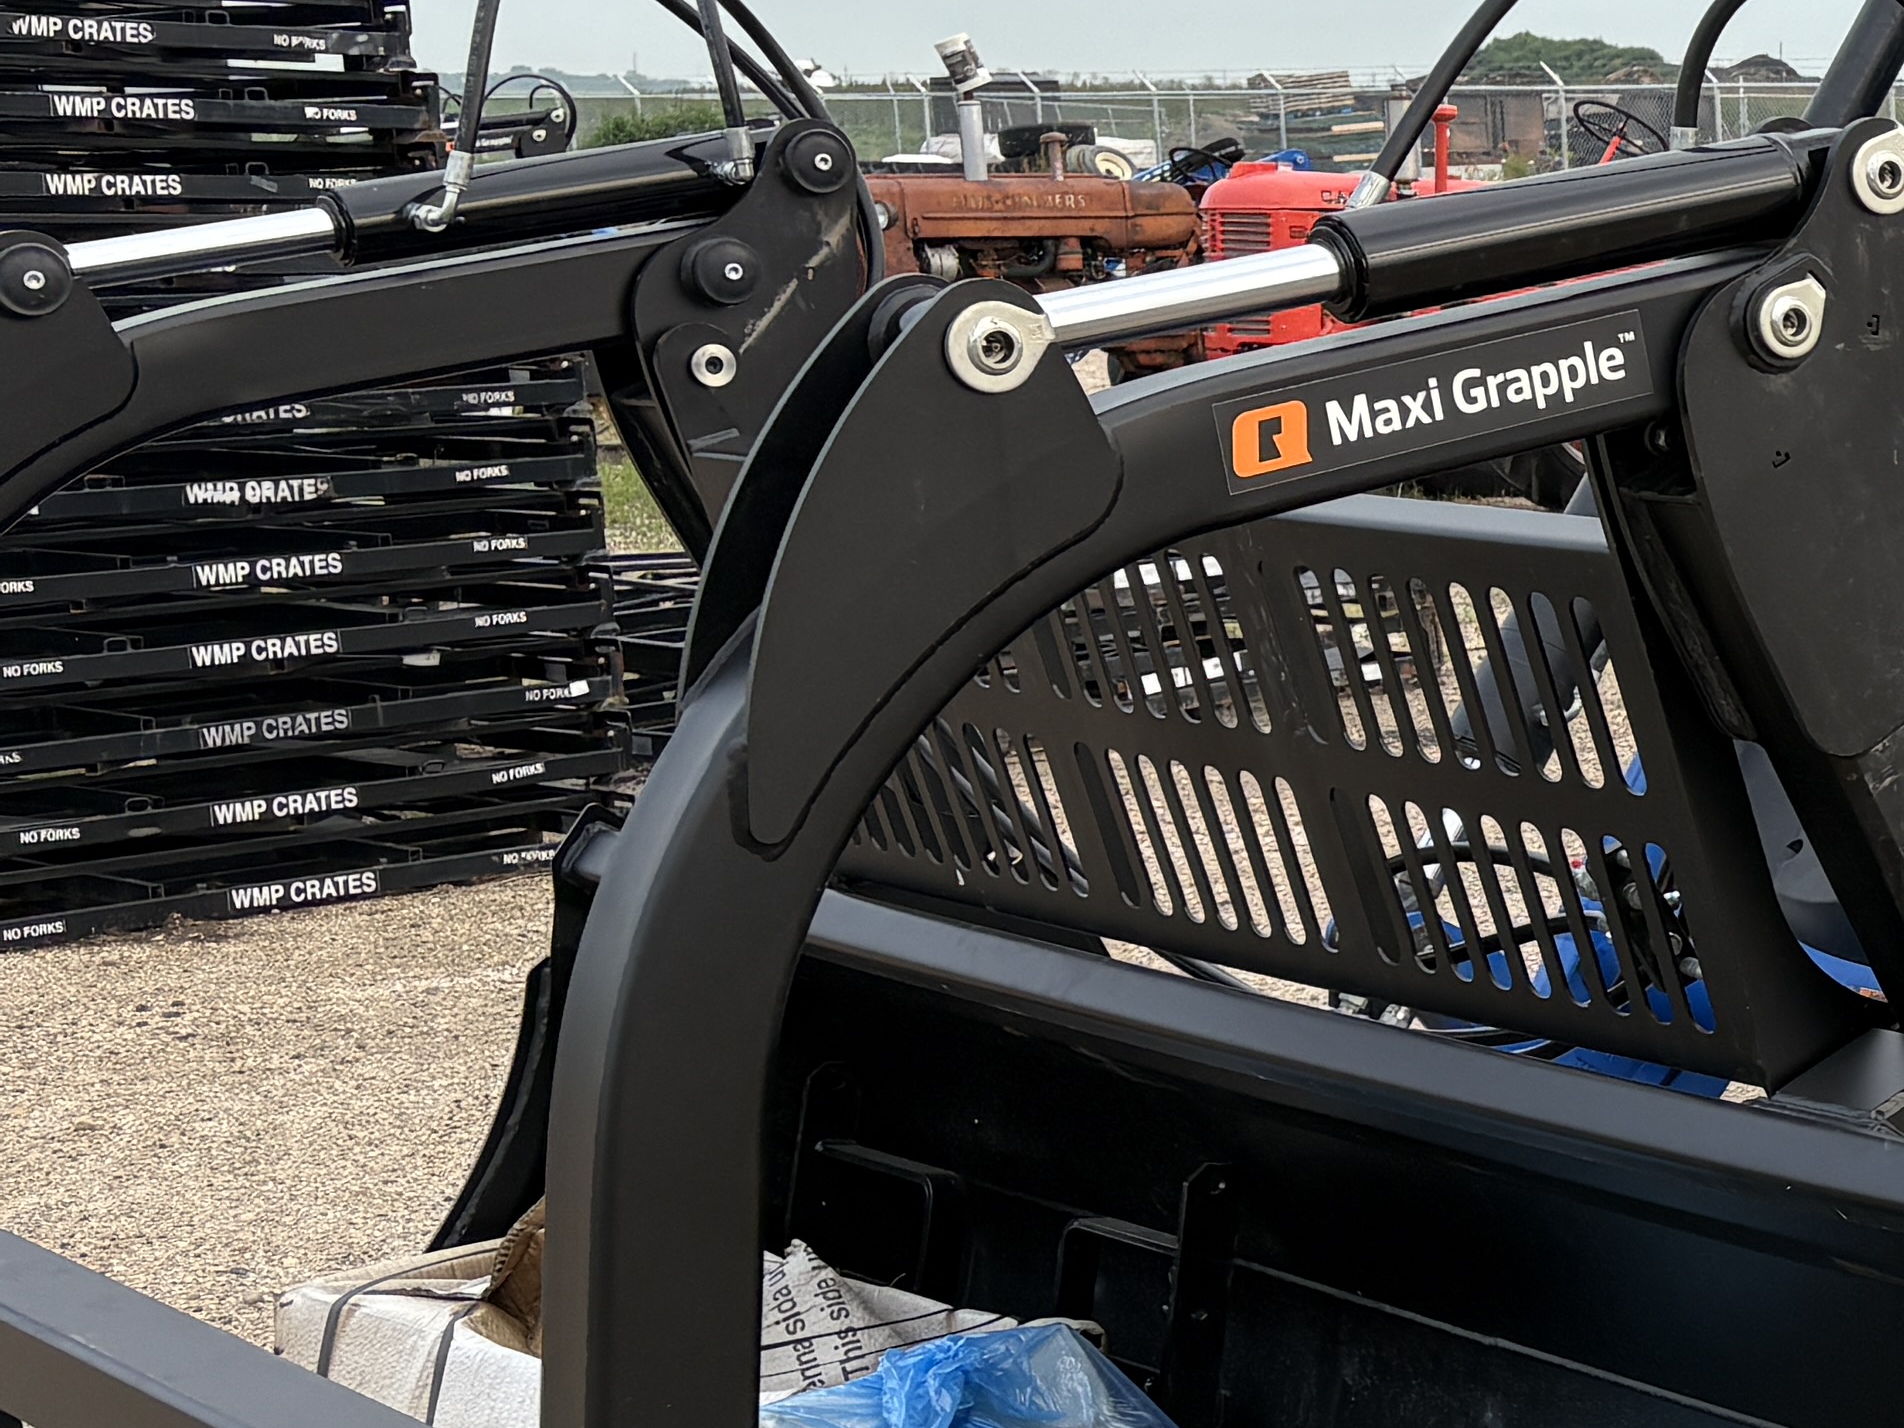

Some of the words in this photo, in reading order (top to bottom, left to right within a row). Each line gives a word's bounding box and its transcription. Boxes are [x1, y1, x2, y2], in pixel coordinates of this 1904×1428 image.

[12, 15, 62, 37] WMP
[68, 18, 155, 43] CRATES
[54, 95, 106, 117] WMP
[111, 97, 195, 120] CRATES
[46, 173, 96, 195] WMP
[101, 174, 182, 196] CRATES
[1324, 377, 1444, 445] Maxi
[456, 471, 471, 482] NO
[473, 540, 489, 552] NO
[196, 561, 250, 586] WMP
[256, 553, 342, 580] CRATES
[0, 581, 34, 593] ORKS
[475, 615, 490, 628] NO
[192, 642, 246, 667] WMP
[251, 632, 338, 661] CRATES
[3, 665, 20, 677] NO
[23, 661, 64, 675] FORKS
[203, 722, 256, 748] WMP
[262, 709, 348, 739] CRATES
[492, 771, 507, 784] NO
[214, 800, 266, 825] WMP
[273, 787, 358, 817] CRATES
[20, 830, 38, 843] NO
[40, 828, 80, 842] FORKS
[231, 885, 284, 909] WMP
[290, 872, 376, 902] CRATES
[3, 928, 20, 941] NO
[23, 921, 63, 937] FORKS
[814, 1277, 850, 1321] side
[834, 1326, 870, 1382] This
